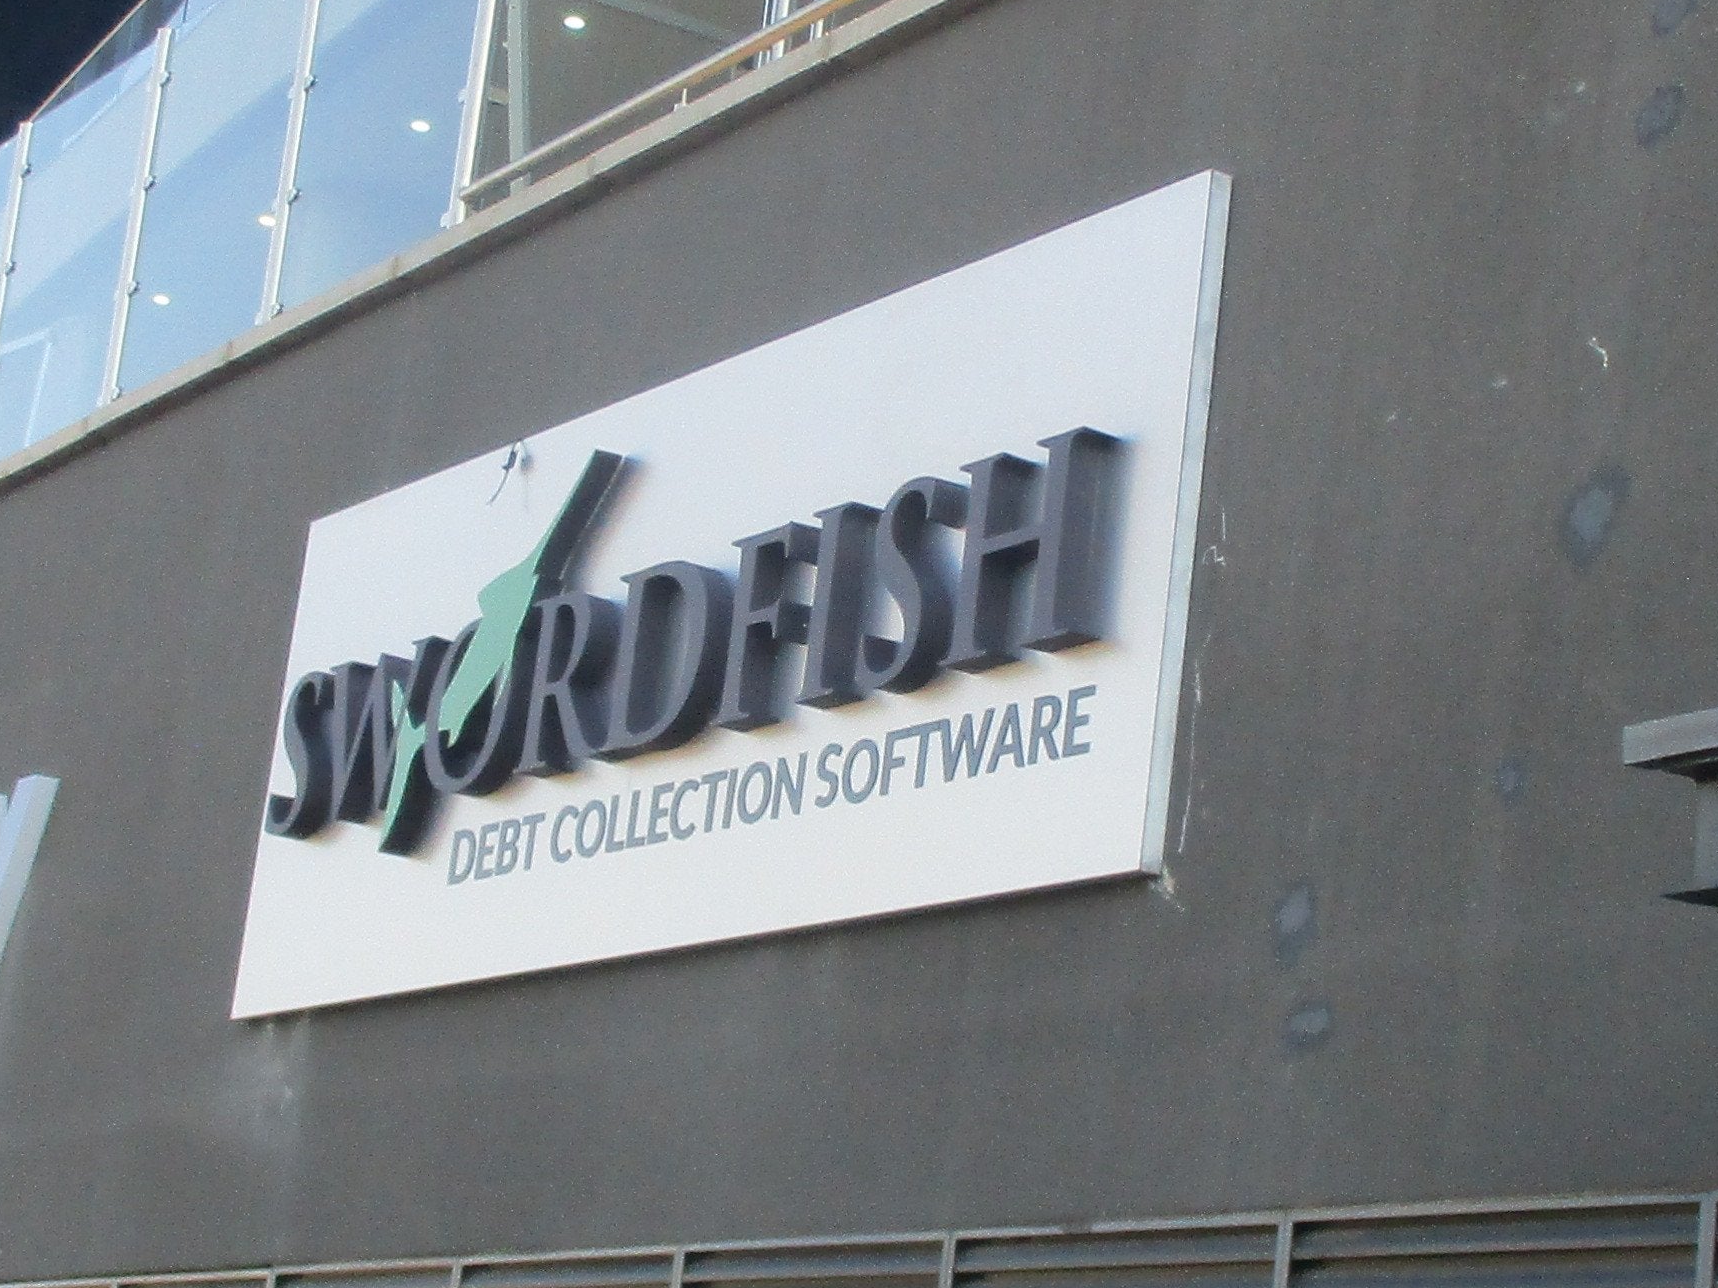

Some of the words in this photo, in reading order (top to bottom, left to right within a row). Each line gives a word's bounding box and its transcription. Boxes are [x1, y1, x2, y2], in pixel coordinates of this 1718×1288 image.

[266, 426, 1125, 854] SWORDFISH
[447, 812, 546, 885] DEBT
[549, 753, 809, 866] COLLECTION
[814, 685, 1097, 808] SOFTWARE
